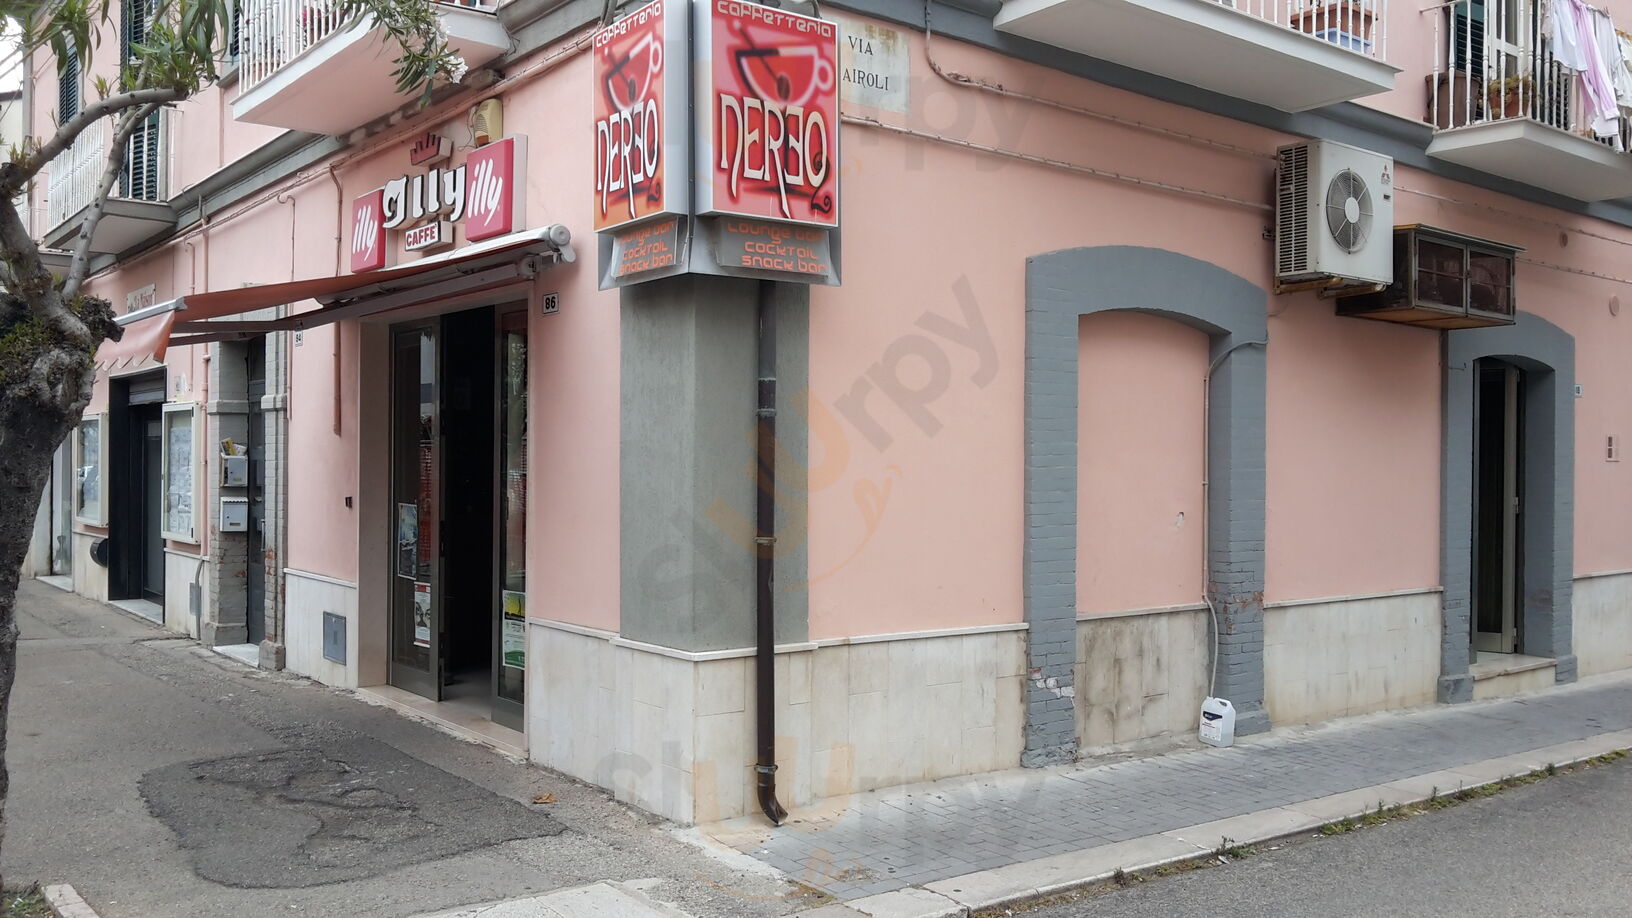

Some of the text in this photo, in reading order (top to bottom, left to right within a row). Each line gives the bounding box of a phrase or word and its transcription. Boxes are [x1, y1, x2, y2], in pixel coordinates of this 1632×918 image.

[848, 35, 873, 56] VIA
[842, 67, 889, 91] AIROLI
[468, 158, 503, 227] illy
[352, 205, 378, 262] illy
[544, 295, 556, 310] 86
